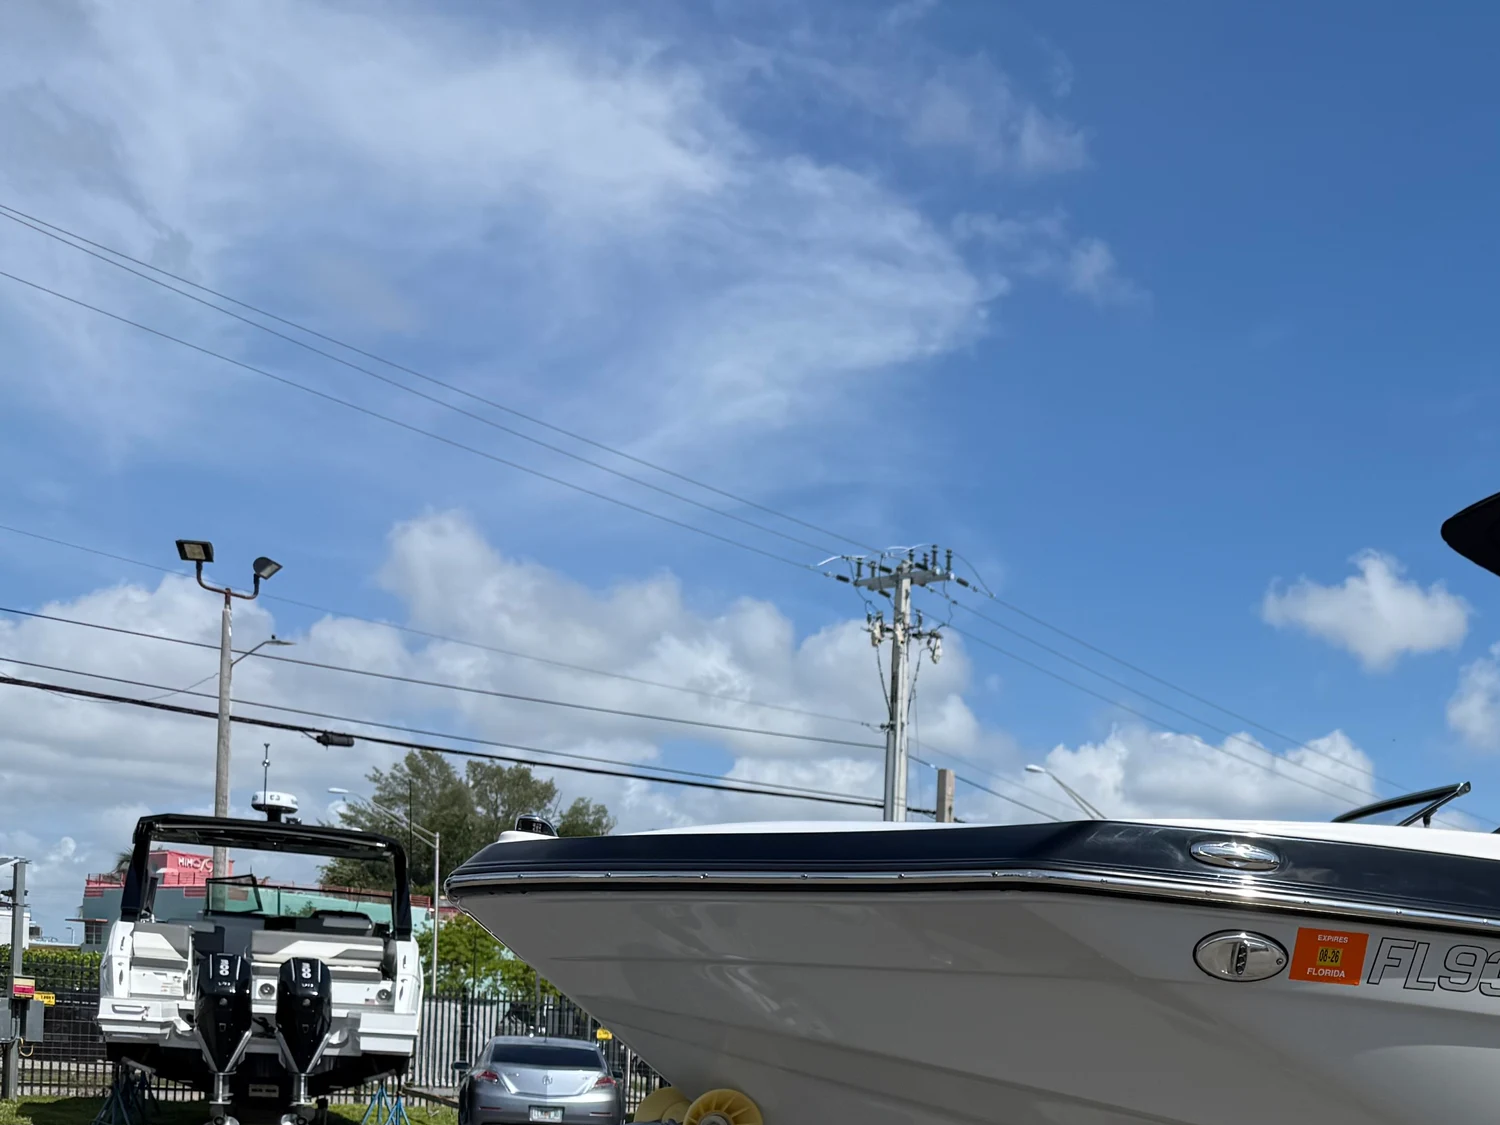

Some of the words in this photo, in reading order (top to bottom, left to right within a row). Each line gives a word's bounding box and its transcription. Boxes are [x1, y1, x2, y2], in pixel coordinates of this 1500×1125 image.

[1317, 934, 1349, 944] EXPIRES
[1319, 949, 1340, 963] 08-26
[1306, 967, 1346, 978] FLORIDA
